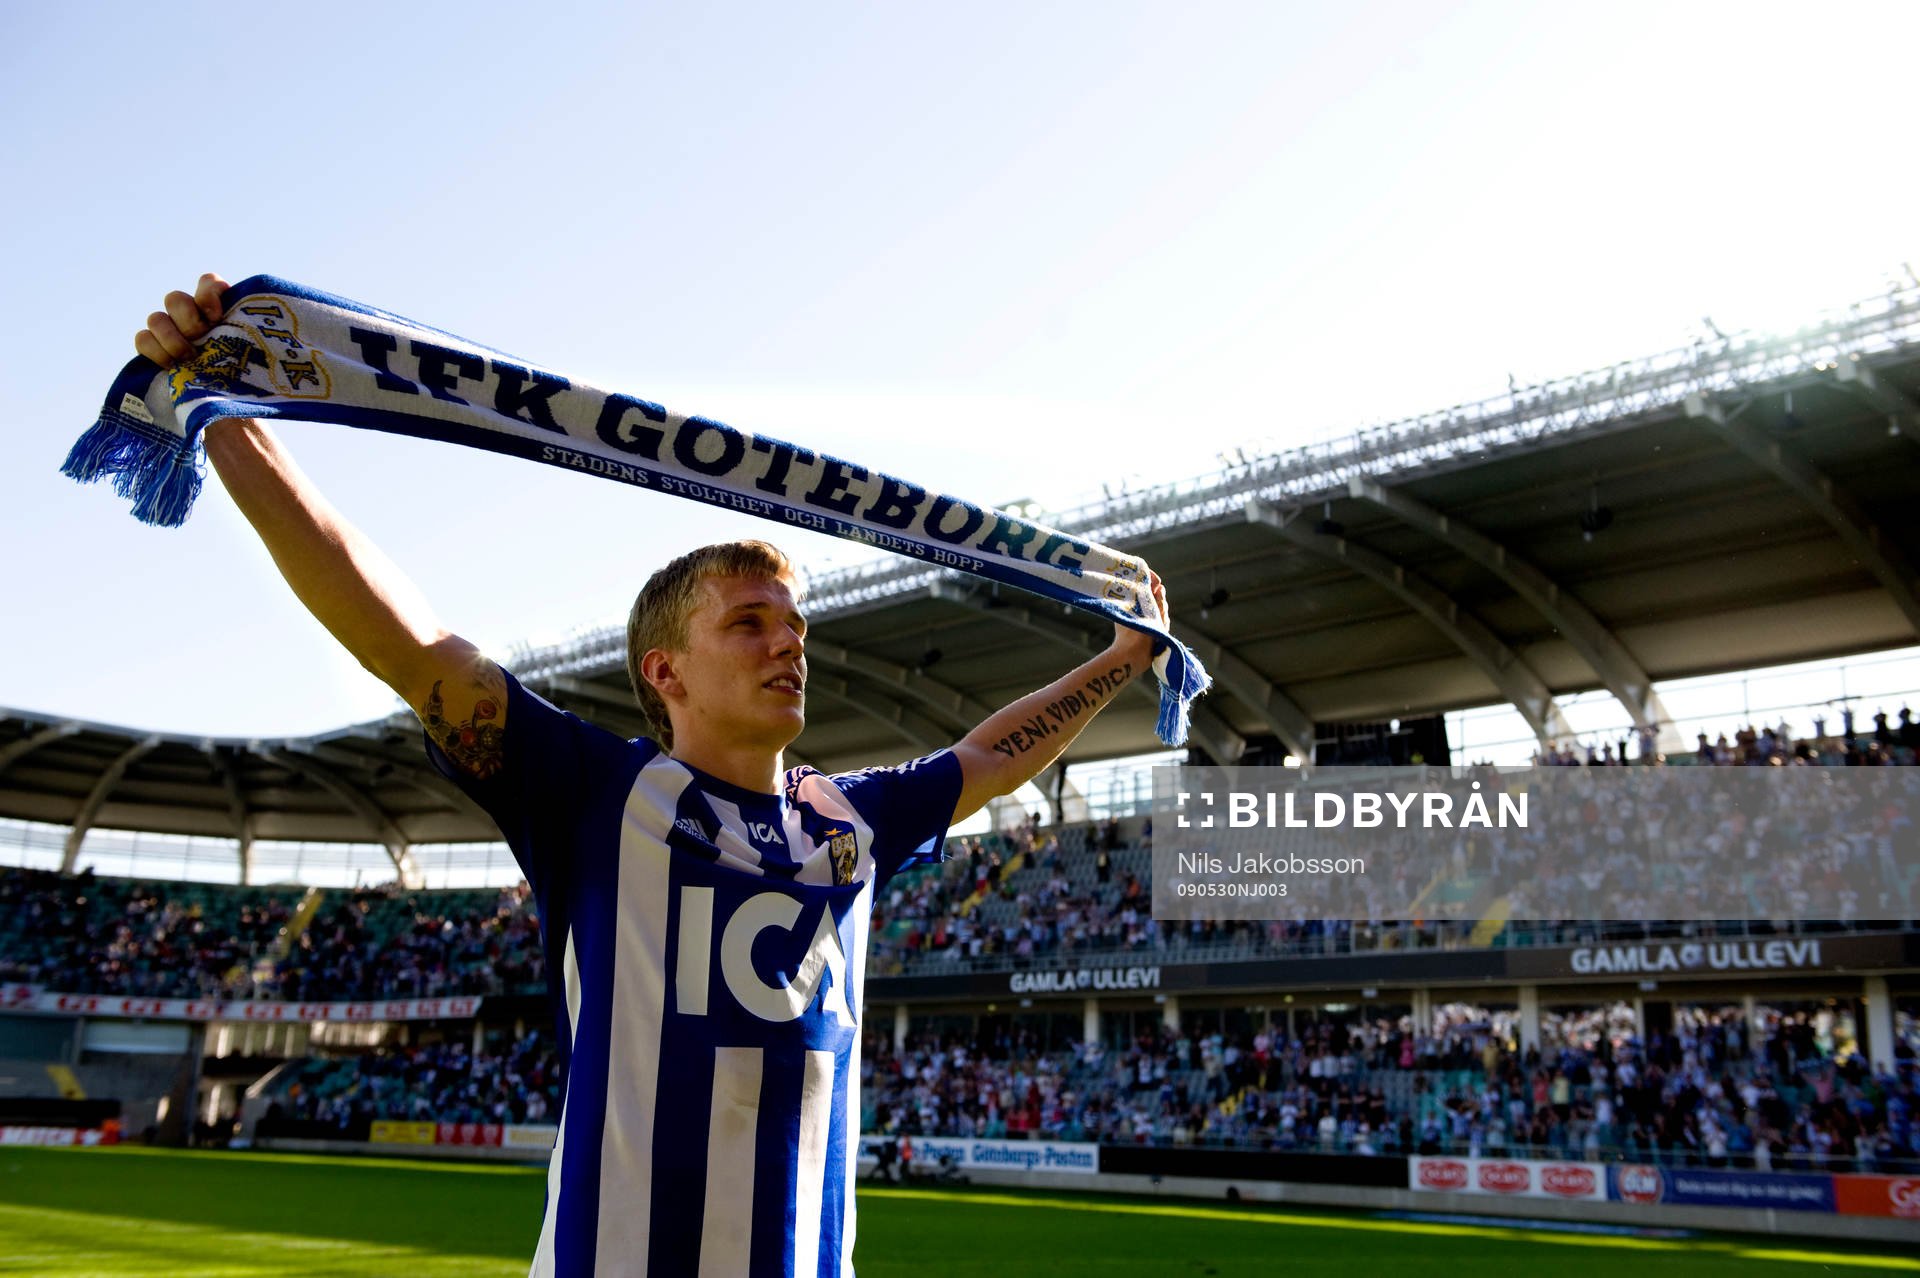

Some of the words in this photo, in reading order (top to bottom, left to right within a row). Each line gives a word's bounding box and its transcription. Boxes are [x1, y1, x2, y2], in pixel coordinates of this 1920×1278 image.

[349, 327, 571, 435] IFK
[542, 446, 649, 484] STADENS
[661, 476, 774, 517] STOLTHET
[785, 508, 826, 529] OCH
[836, 521, 925, 556] LANDETS
[934, 548, 985, 572] HOPP
[749, 822, 784, 844] ICA
[676, 886, 857, 1028] ICA
[1009, 971, 1076, 993] GAMLA
[1093, 967, 1161, 989] ULLEVI
[1570, 946, 1679, 973] GAMLA
[1709, 939, 1822, 969] ULLEVI
